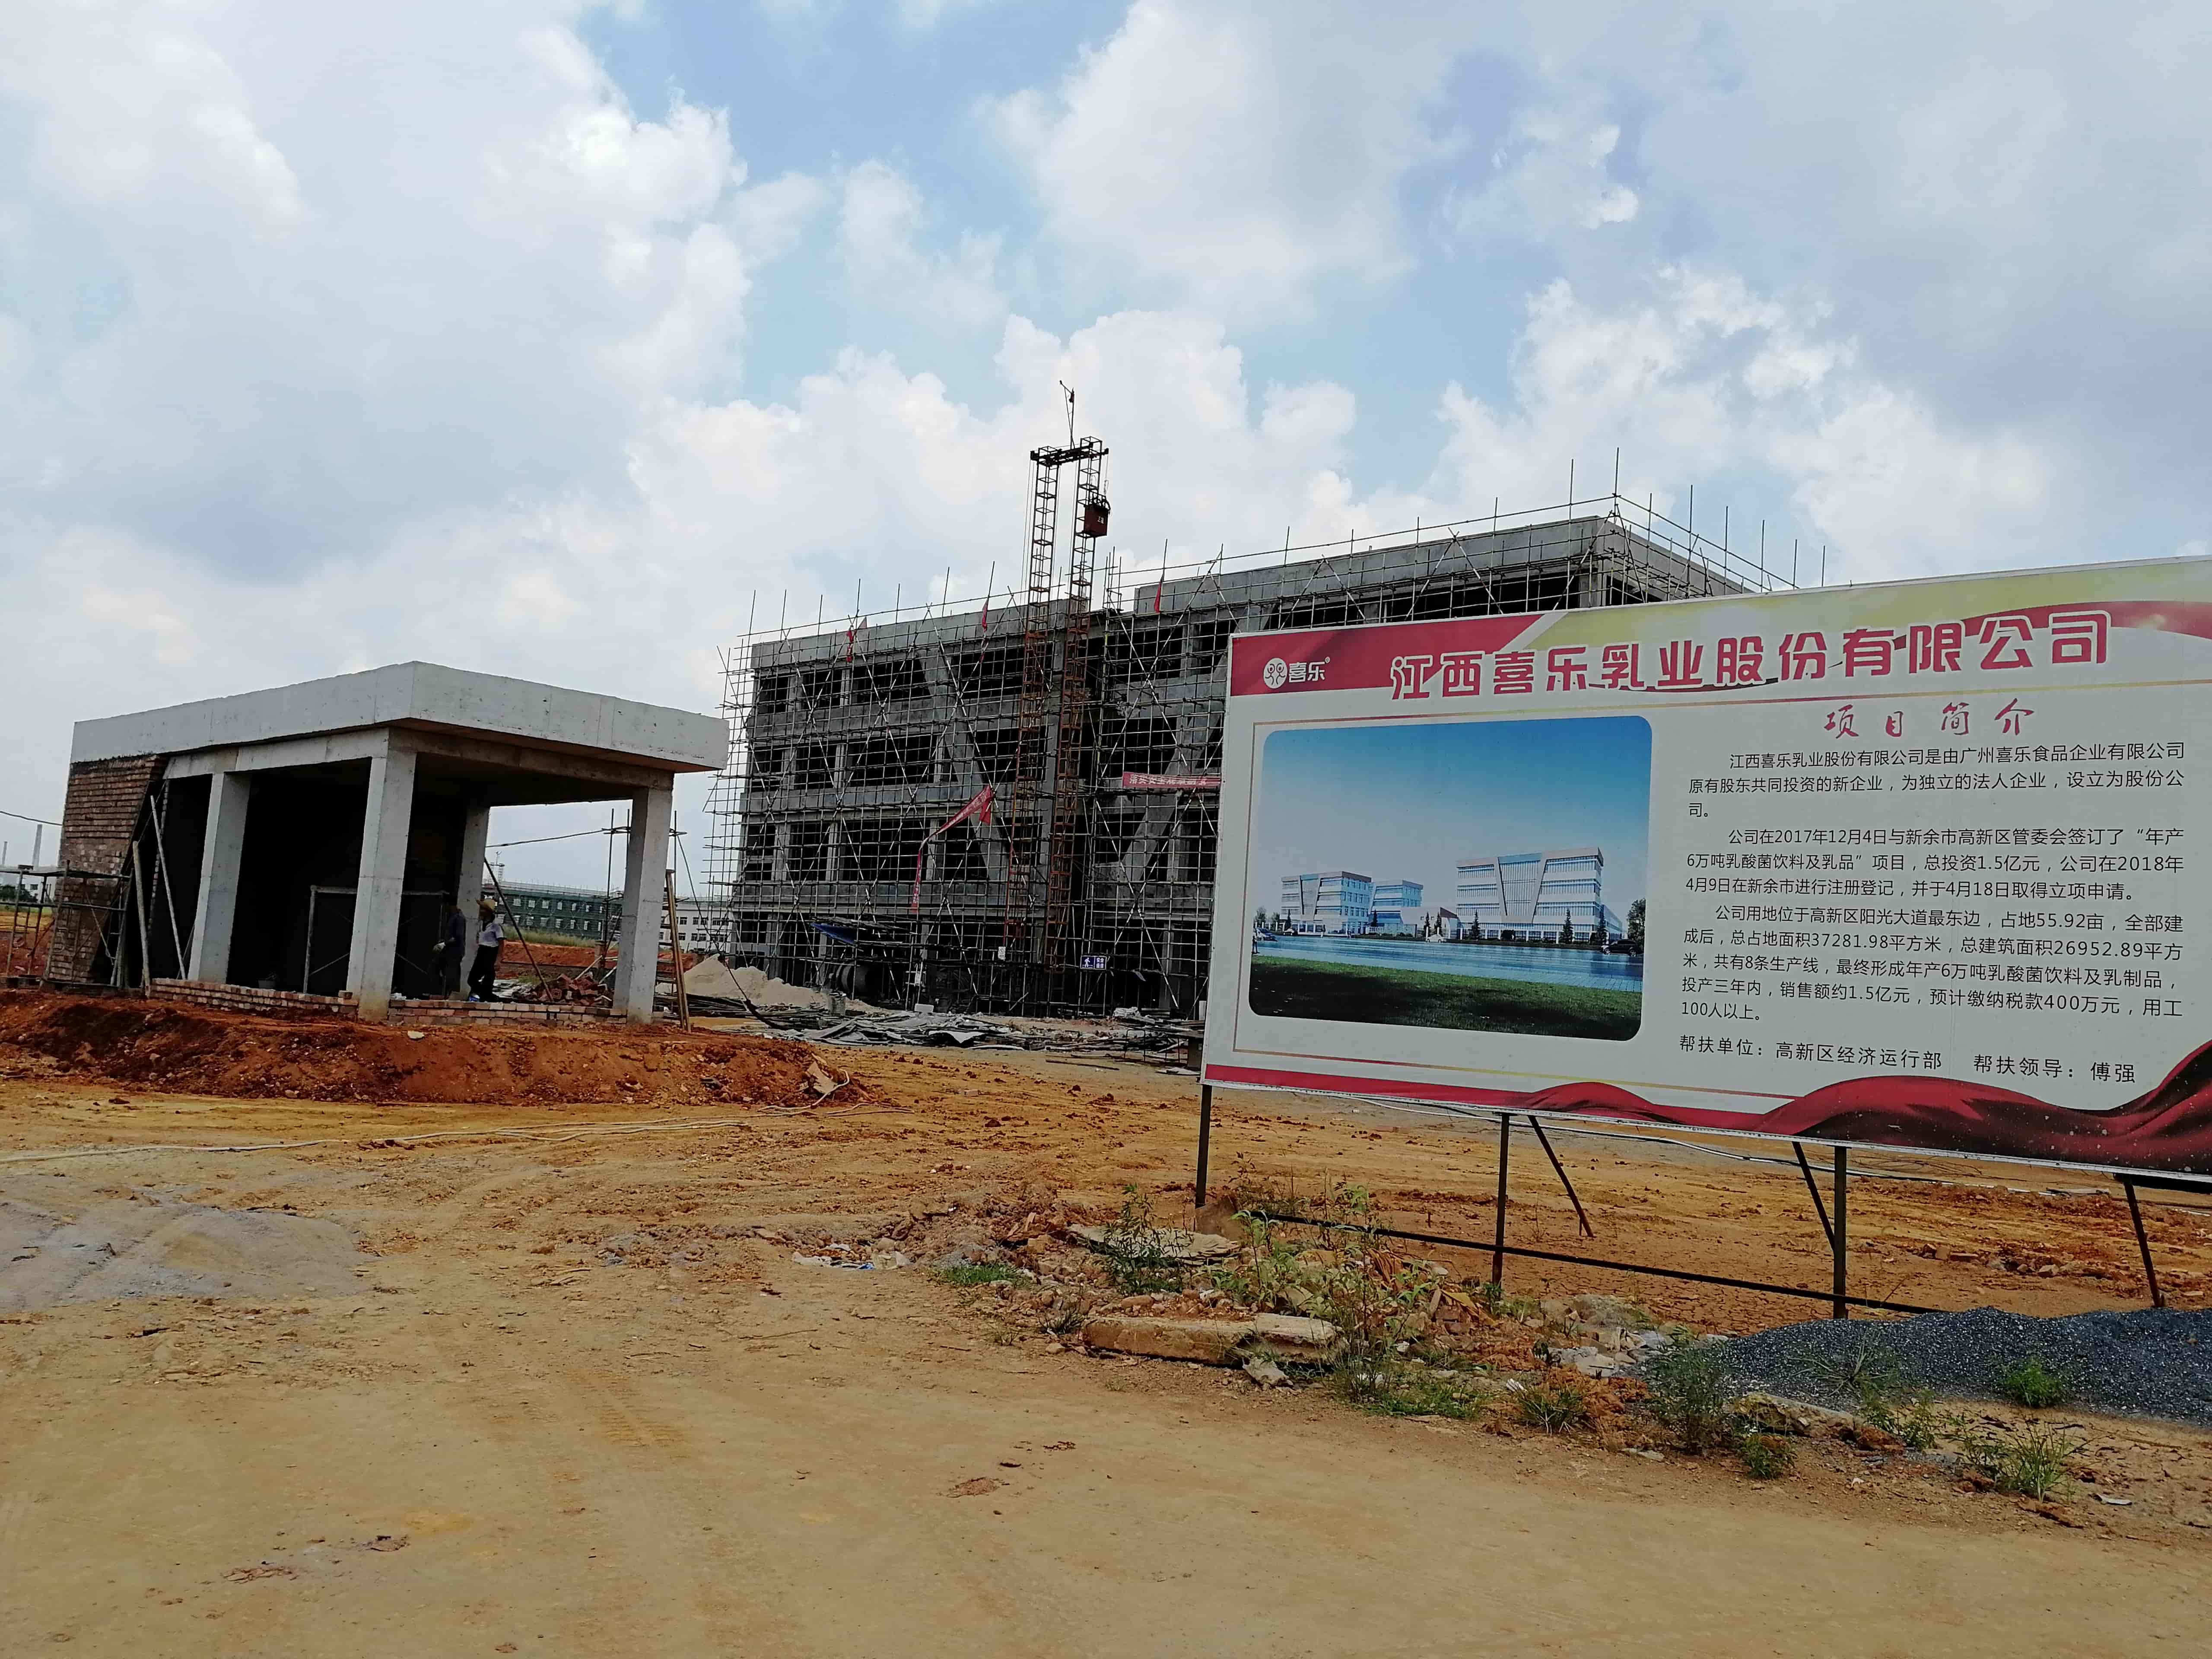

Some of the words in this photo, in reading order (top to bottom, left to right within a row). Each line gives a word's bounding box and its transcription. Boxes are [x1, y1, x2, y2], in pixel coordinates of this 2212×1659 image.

[1391, 613, 2107, 700] 江西喜乐乳业股份有限公司
[1729, 741, 2185, 769] 江西喜乐乳业股份有限公司是由广州喜乐食品企业有限公司
[1688, 769, 2185, 794] 原有股东共同投资的新企业，为独立的法人企业，设立为股份公
[1688, 802, 1710, 818] 司。
[1728, 827, 2185, 846] 公司在2017年12月4日与新余市高新区管委会签订了“年产
[1686, 853, 2185, 874] 6万吨乳酸菌饮料及乳品”项目，总投资1.5亿元，公司在2018年
[1685, 877, 2132, 901] 4月9日在新余市进行注册登记，并于4月18日取得立项申请。
[1715, 905, 2184, 933] 公司用地位于高新区阳光大道最东边，占地55.92亩，全部建
[1683, 928, 2184, 961] 成后，总占地面积37281.98平方米，总建筑面积26952.89平方
[1683, 952, 2177, 989] 米，共有8条生产线，最终形成年产6万吨乳酸菌饮料及乳制品，
[1681, 976, 2183, 1017] 投产三年内，销售额约1.5亿元，预计缴纳税款400万元，用工
[1681, 1001, 1761, 1021] 100人以上。
